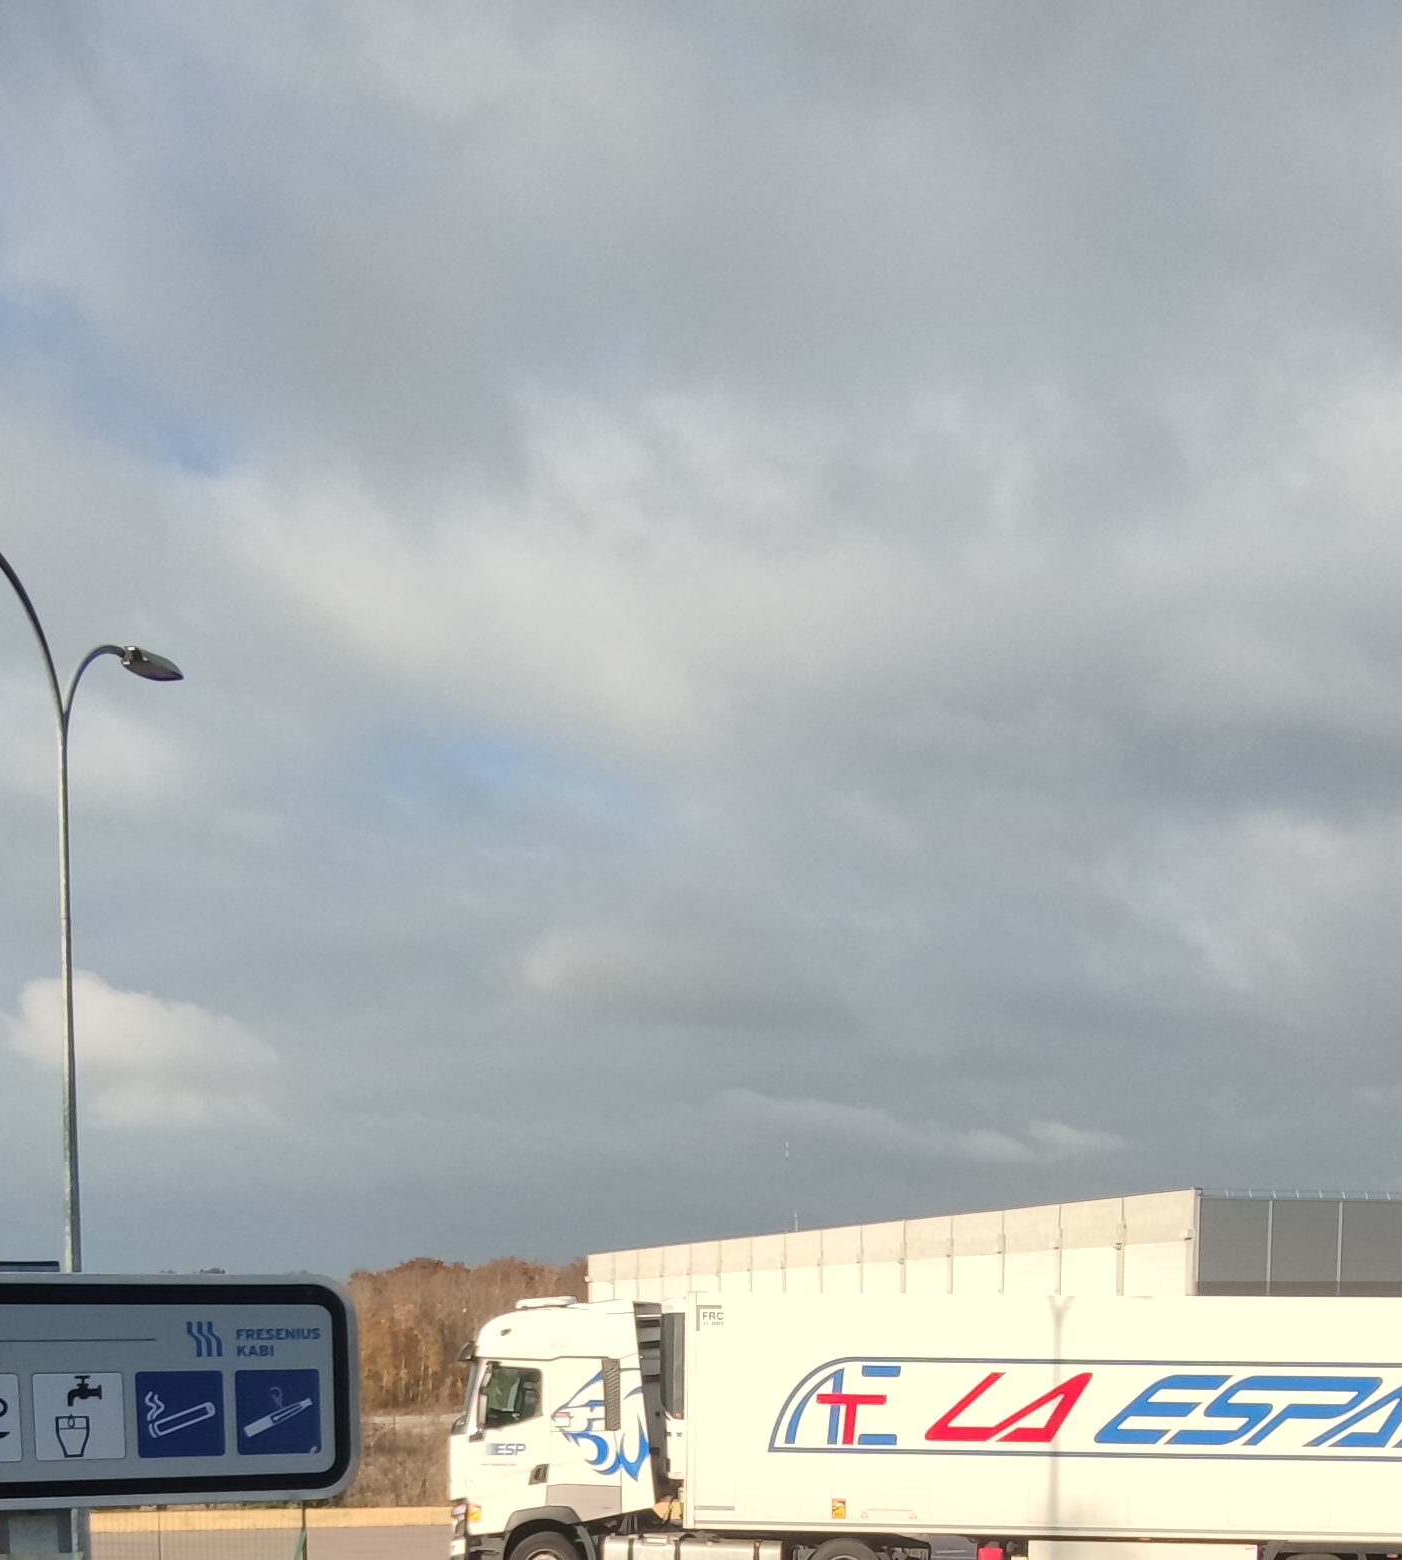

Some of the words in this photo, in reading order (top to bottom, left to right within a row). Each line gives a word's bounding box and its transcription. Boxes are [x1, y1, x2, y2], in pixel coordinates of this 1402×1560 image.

[702, 1311, 724, 1321] FRC
[236, 1327, 321, 1341] FRESENIUS
[237, 1344, 275, 1357] KABI
[924, 1372, 1094, 1443] LA
